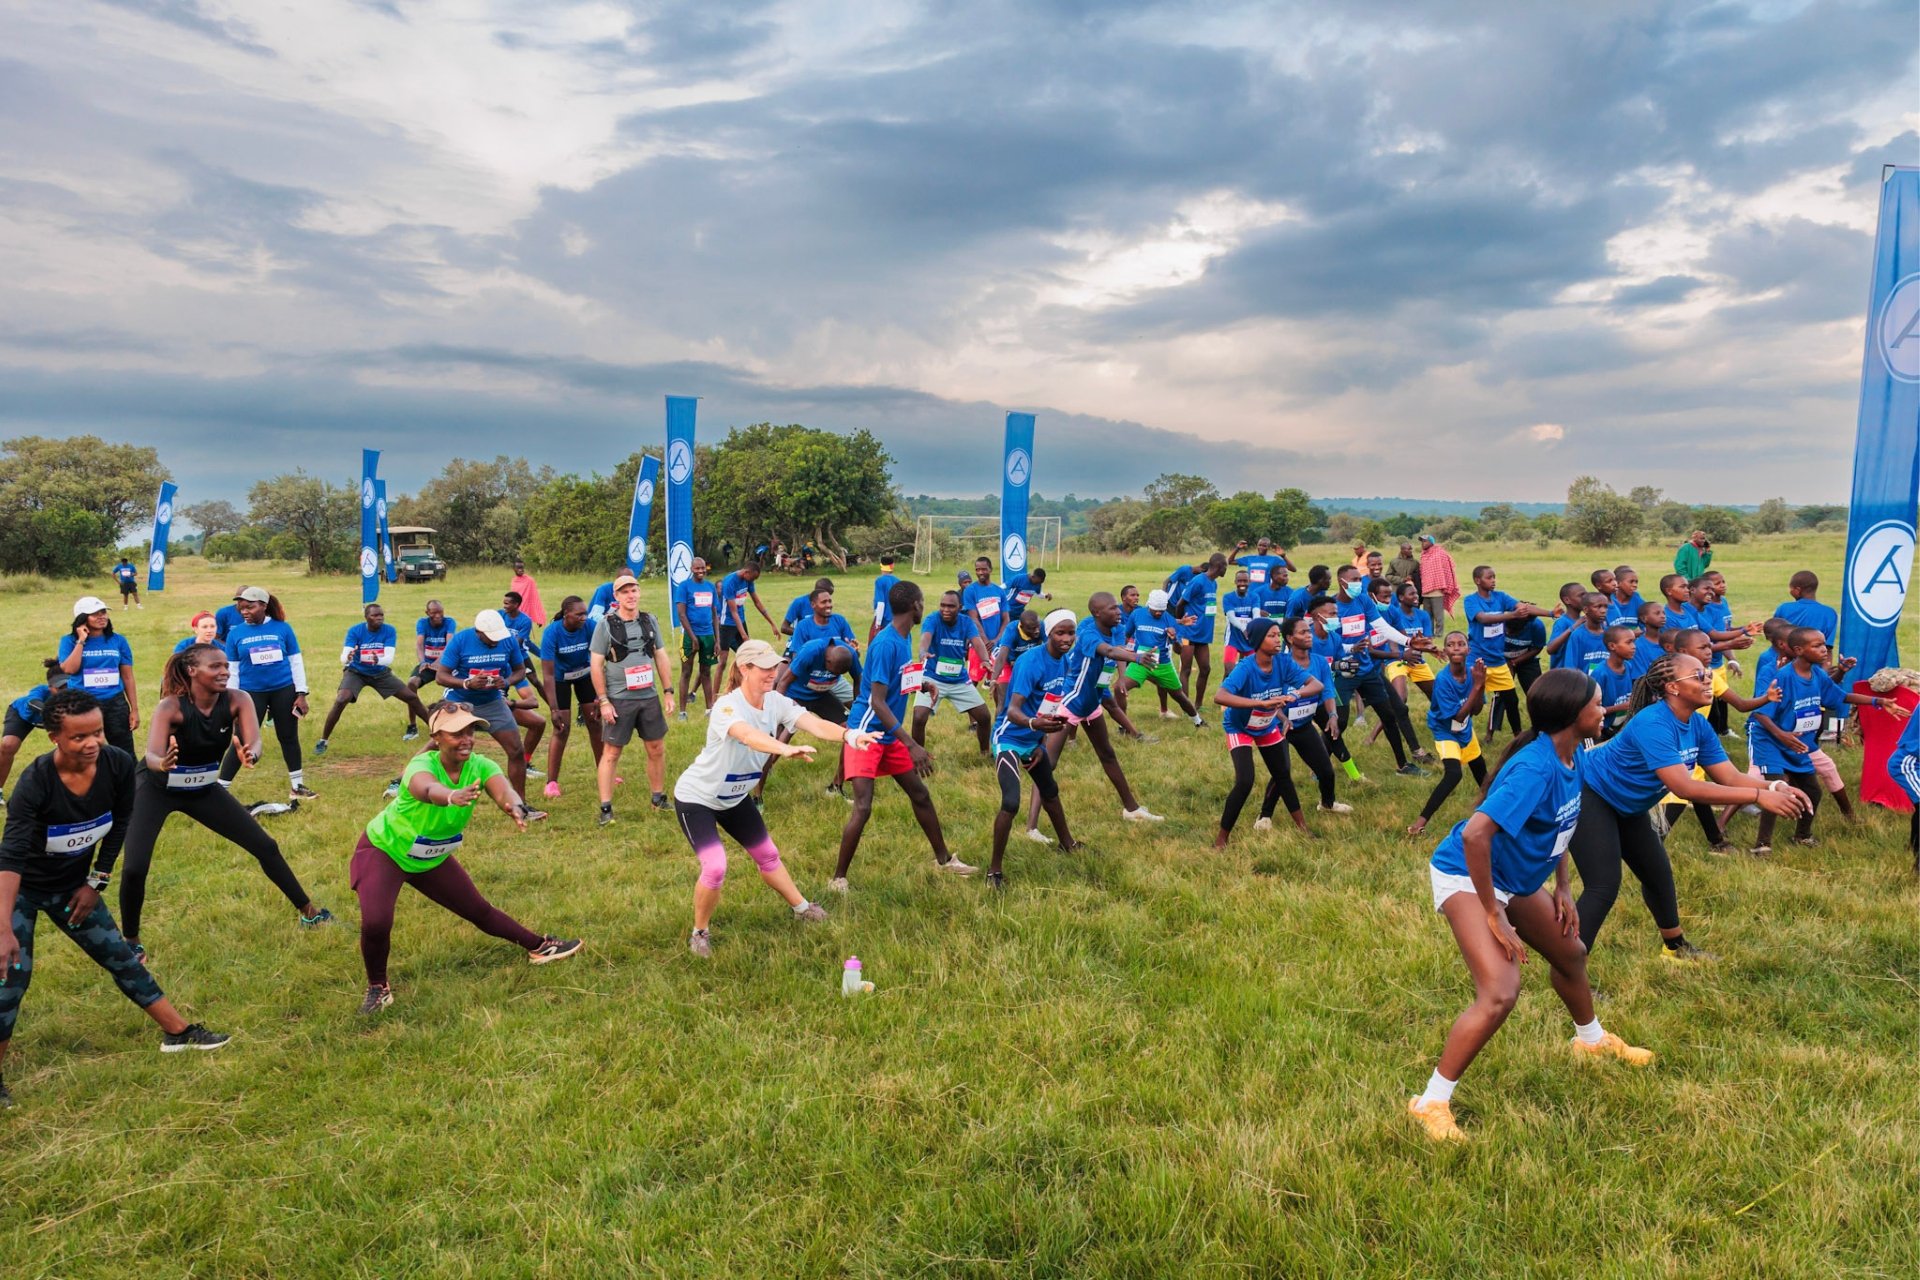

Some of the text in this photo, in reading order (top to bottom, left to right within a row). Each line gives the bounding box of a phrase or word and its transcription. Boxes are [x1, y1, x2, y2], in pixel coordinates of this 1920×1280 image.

[671, 448, 687, 470] A
[1011, 457, 1026, 475] A
[1008, 542, 1023, 560] A
[673, 550, 689, 574] A
[1862, 545, 1905, 594] A
[184, 775, 205, 784] 012
[731, 784, 746, 793] 031
[67, 834, 93, 848] 026
